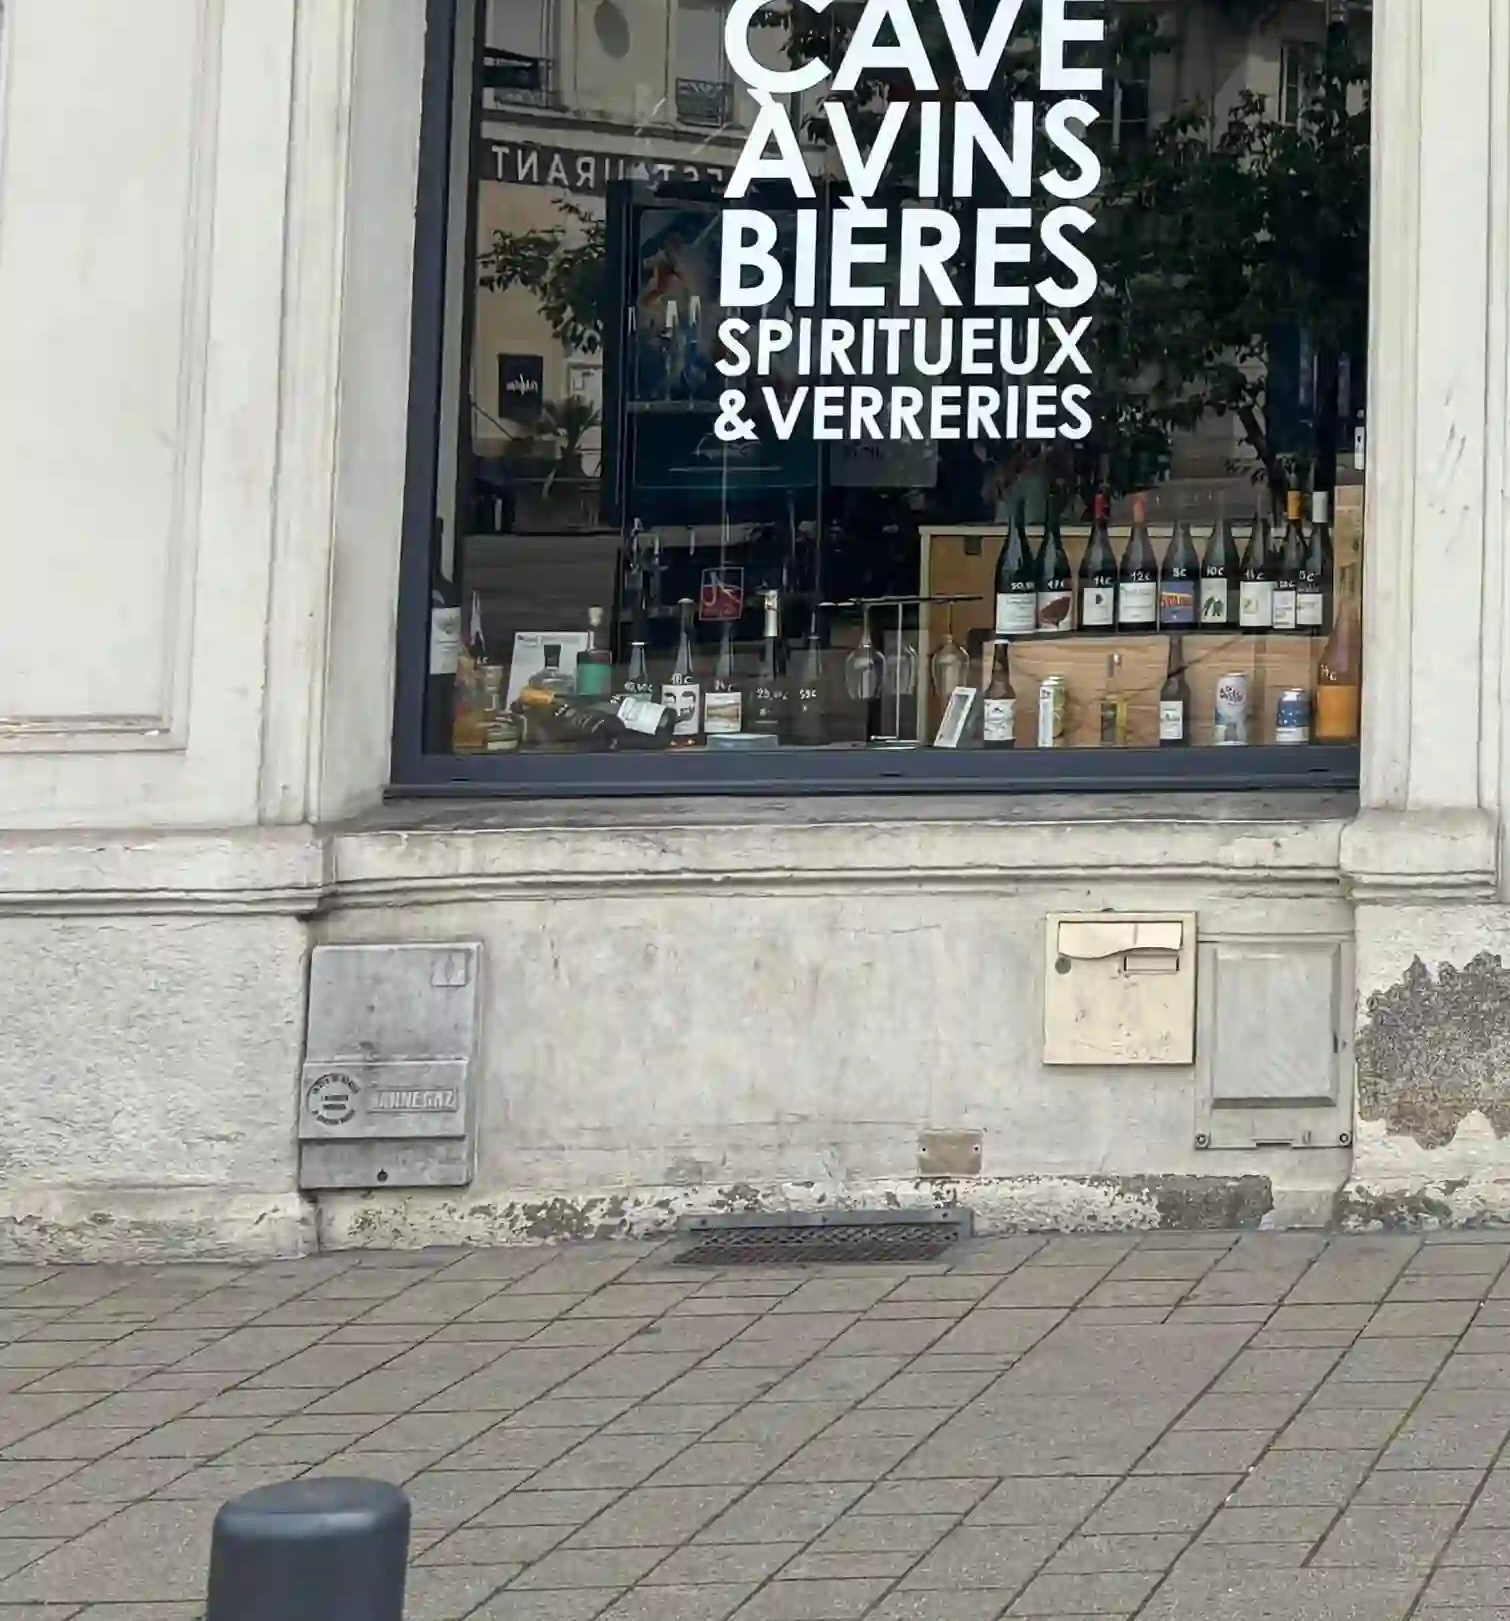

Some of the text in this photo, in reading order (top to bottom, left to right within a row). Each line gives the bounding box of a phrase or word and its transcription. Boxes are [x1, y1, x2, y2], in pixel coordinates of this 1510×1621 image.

[723, 88, 1101, 199] À VINS
[720, 196, 1099, 308] BIÈRES
[714, 316, 1093, 376] SPIRITUEUX
